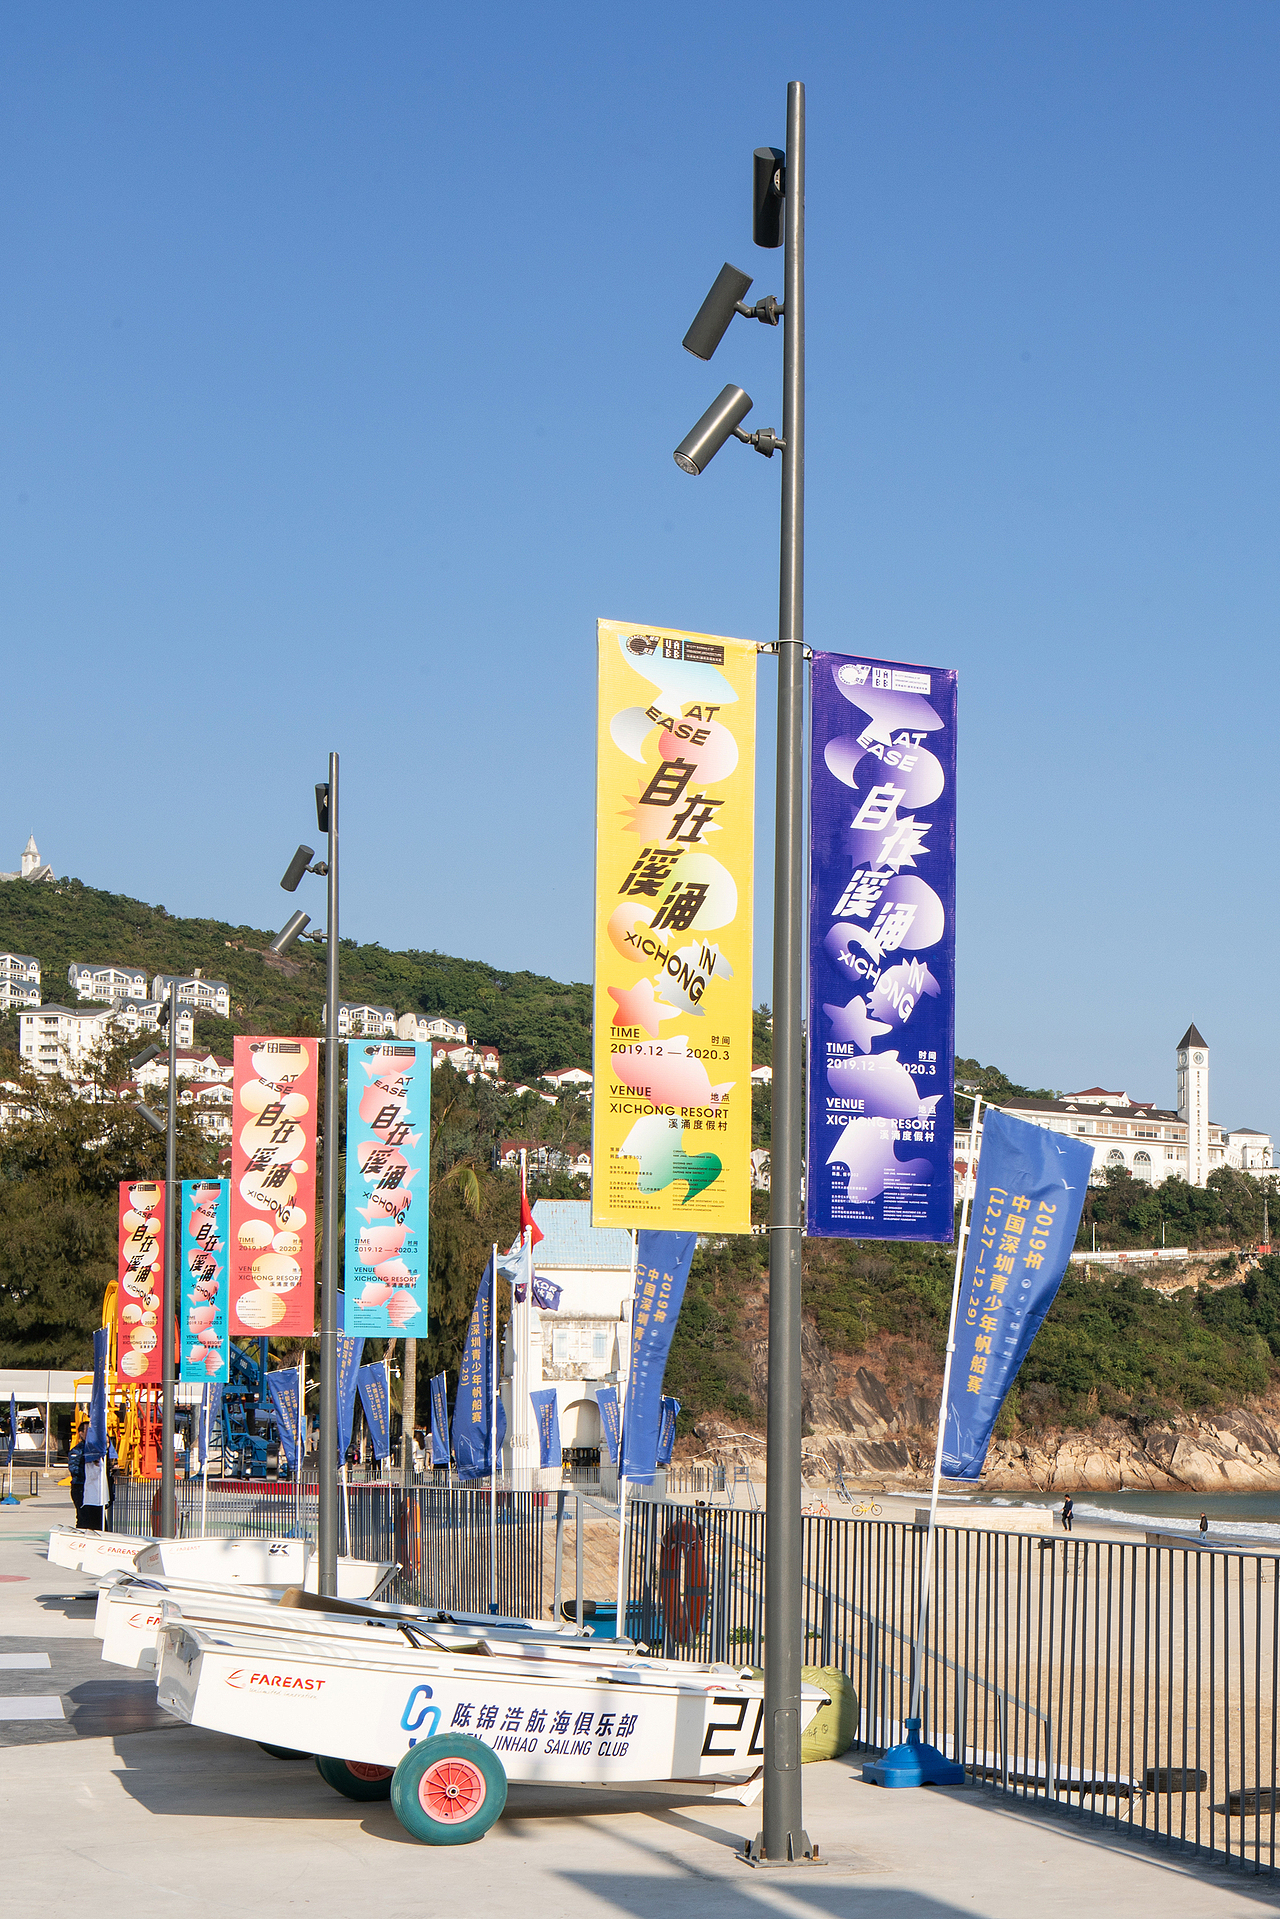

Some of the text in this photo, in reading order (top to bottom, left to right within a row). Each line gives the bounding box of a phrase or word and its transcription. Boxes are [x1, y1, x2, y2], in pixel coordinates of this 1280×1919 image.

[685, 705, 721, 722] AT
[645, 706, 711, 746] EASE
[892, 732, 928, 749] AT
[856, 734, 919, 772] EASE
[624, 931, 706, 1005] XICHONG
[698, 945, 716, 976] IN
[837, 950, 915, 1023] XICHONG
[907, 965, 925, 994] IN
[610, 1027, 640, 1039] TIME
[711, 1035, 731, 1045] 时间
[610, 1043, 663, 1056] 2019.12
[686, 1048, 730, 1061] 2020.3
[826, 1042, 854, 1054] TIME
[918, 1050, 937, 1061] 时间
[826, 1058, 875, 1071] 2019.12
[258, 1077, 294, 1095] EASE
[280, 1074, 299, 1083] AT
[394, 1077, 414, 1086] AT
[374, 1079, 409, 1098] EASE
[610, 1085, 651, 1097] VENUE
[710, 1092, 730, 1102] 地点
[610, 1103, 729, 1119] XICHONG RESORT
[826, 1097, 865, 1110] VENUE
[918, 1104, 937, 1114] 地点
[668, 1118, 728, 1131] 溪涌度假村
[826, 1114, 936, 1131] XICHONG RESORT
[880, 1129, 935, 1143] 溪涌度假村
[246, 1190, 291, 1225] XICHONG
[287, 1194, 298, 1210] IN
[362, 1191, 406, 1226] XICHONG
[401, 1196, 412, 1211] IN
[133, 1208, 152, 1219] EASE
[197, 1206, 217, 1219] EASE
[1023, 1200, 1057, 1270] 2019年
[653, 1272, 674, 1323] 2019年
[966, 1195, 1032, 1395] 中国深圳青少年帆船赛
[481, 1296, 493, 1339] 2019年
[250, 1673, 326, 1691] FAREAST
[450, 1702, 639, 1738] 陈锦浩航海俱乐部
[491, 1734, 538, 1753] JINHAO
[544, 1739, 592, 1756] SAILING
[597, 1742, 629, 1757] CLUB
